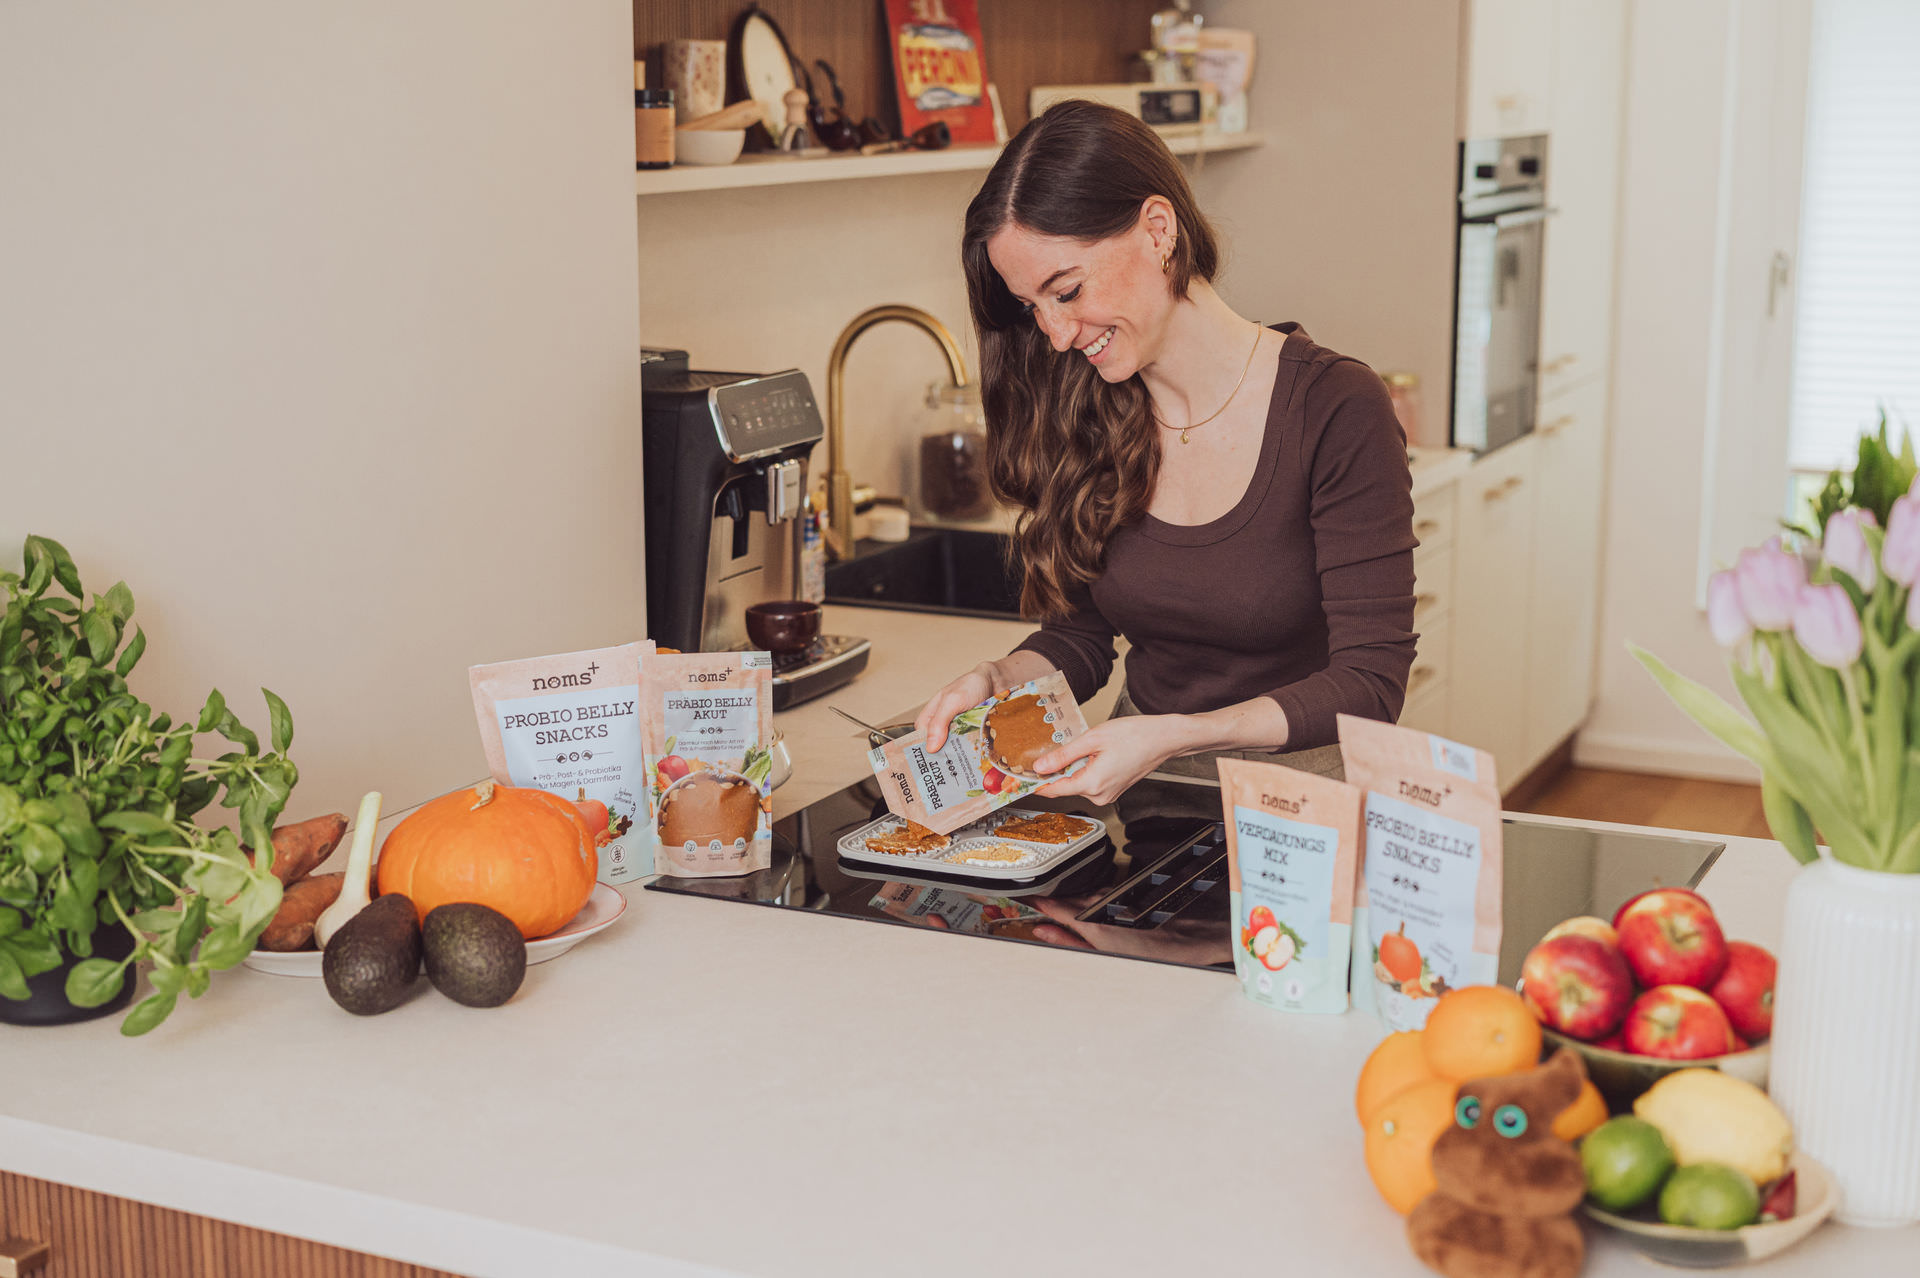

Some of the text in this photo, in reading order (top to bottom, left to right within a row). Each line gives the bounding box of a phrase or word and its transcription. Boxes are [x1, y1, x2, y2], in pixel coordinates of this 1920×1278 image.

[668, 696, 753, 709] PRÄBIO BELLY
[503, 701, 635, 729] PROBIO BELLY
[693, 710, 728, 720] AKUT
[535, 724, 609, 745] SNACKS
[585, 765, 622, 775] Probiotika
[912, 747, 943, 810] PRÄBIO BELLY
[928, 760, 946, 786] AKUT
[549, 780, 575, 789] Magen
[576, 778, 582, 786] &
[583, 774, 621, 785] Darmflora
[1366, 810, 1474, 858] PROBIO BELLY
[1263, 846, 1289, 865] MIX
[1382, 840, 1442, 874] SNACKS
